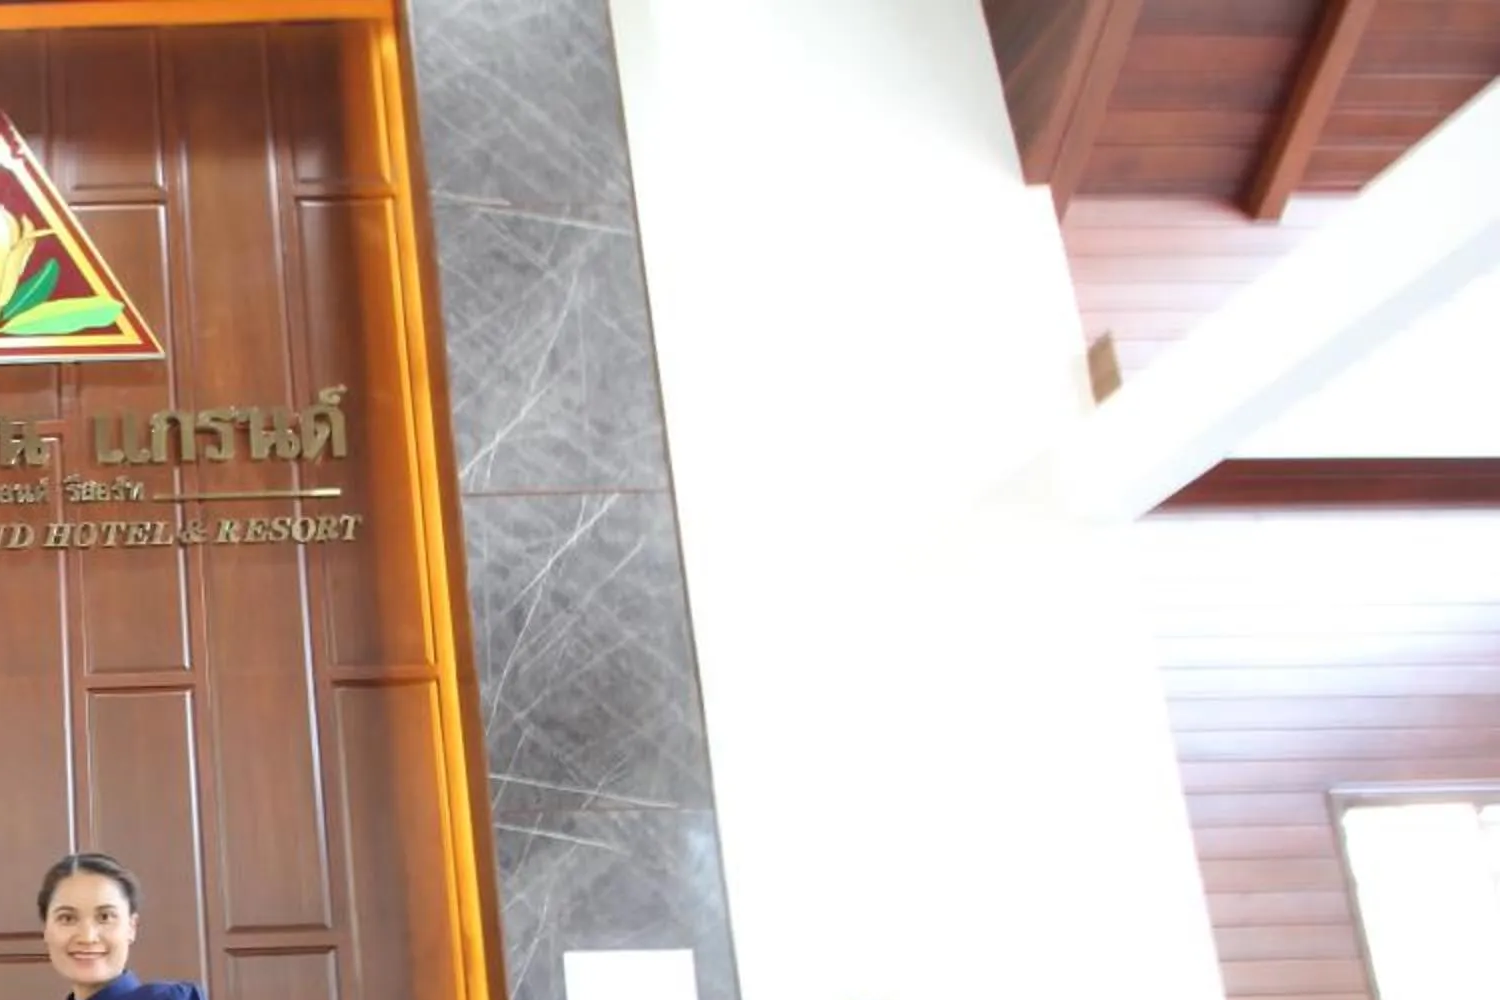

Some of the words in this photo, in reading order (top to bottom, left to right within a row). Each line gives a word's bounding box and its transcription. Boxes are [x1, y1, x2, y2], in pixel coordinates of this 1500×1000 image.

[93, 384, 346, 466] แกรนด์
[43, 520, 174, 549] HOTEL
[177, 518, 207, 545] &
[216, 513, 362, 544] RESORT
